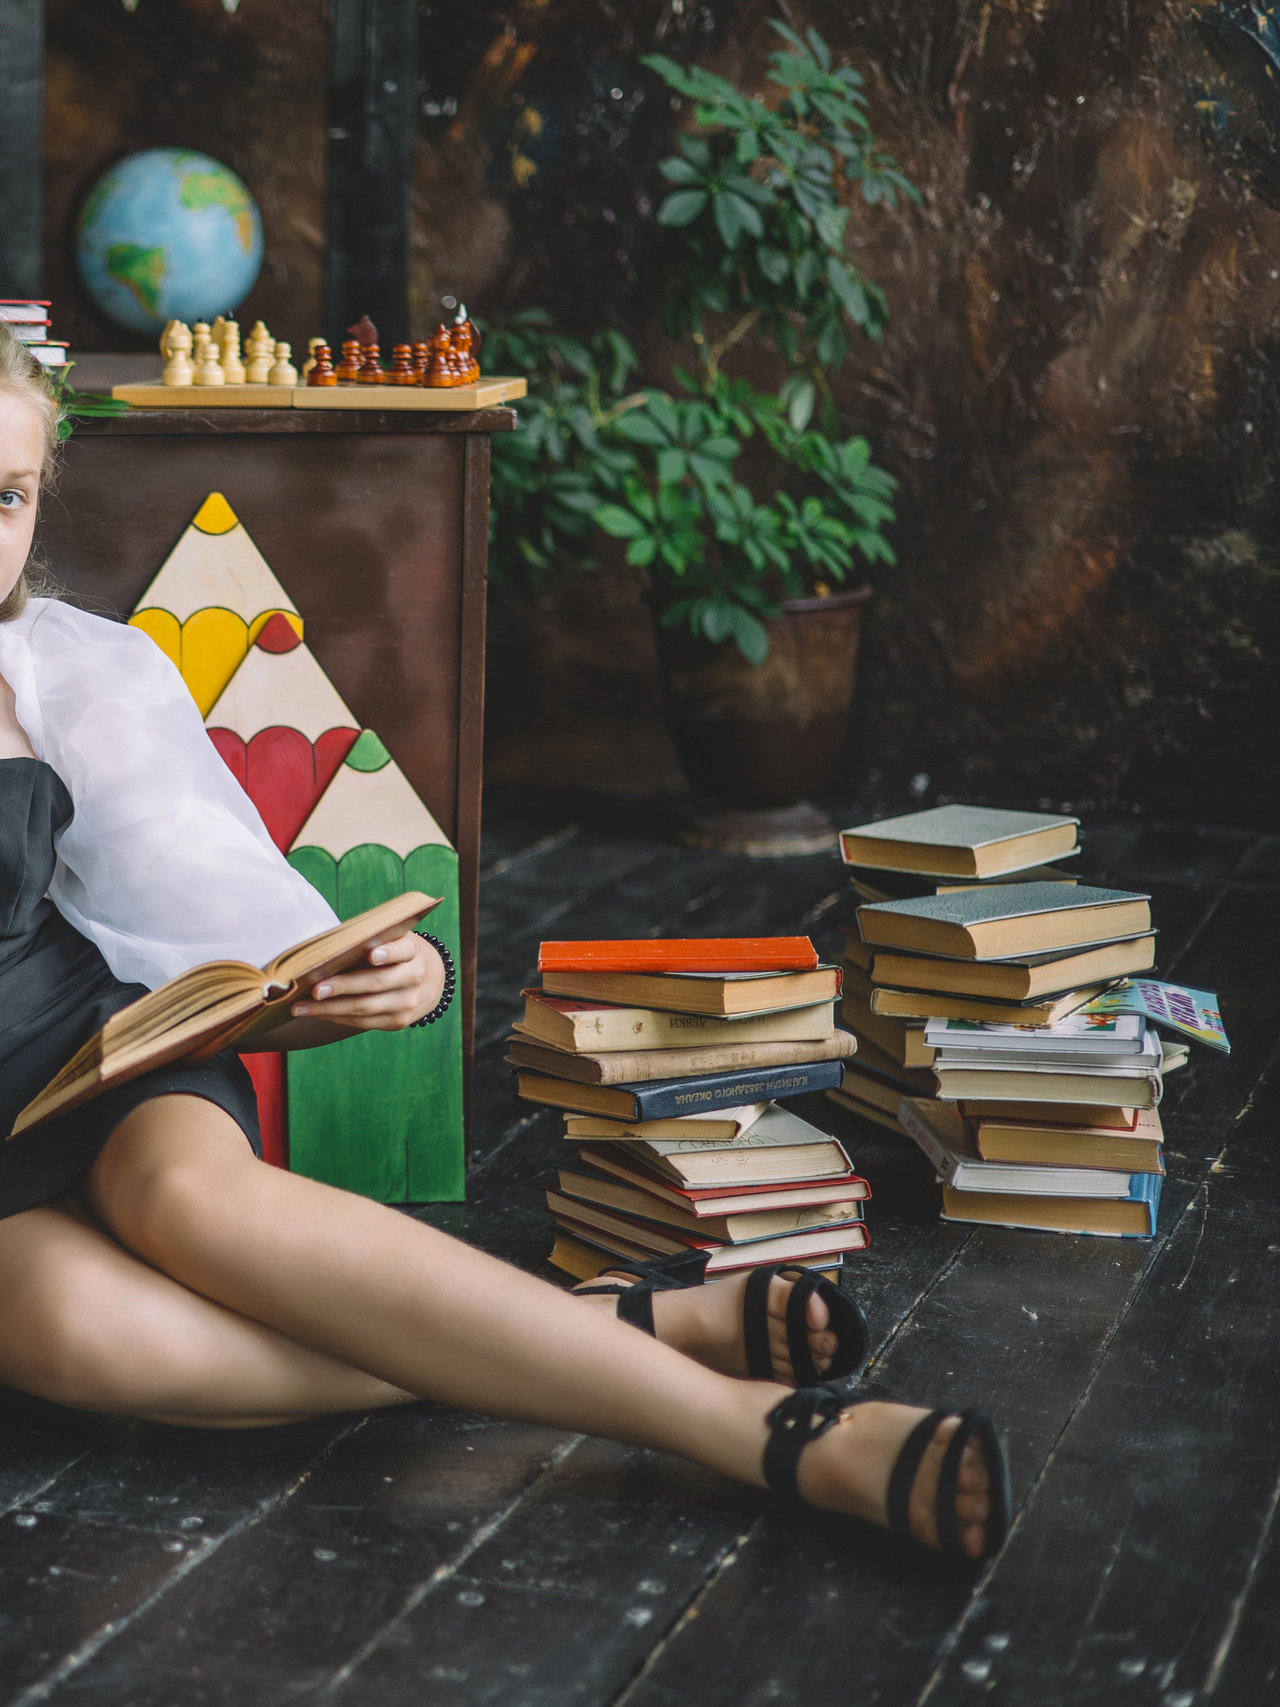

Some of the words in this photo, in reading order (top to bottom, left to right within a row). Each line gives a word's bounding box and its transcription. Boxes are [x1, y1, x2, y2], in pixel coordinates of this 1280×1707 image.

[1164, 991, 1201, 1030] ЧИТАЕМ
[714, 1082, 765, 1099] ЗВЕЗДНОГО
[766, 1075, 808, 1092] КАПИТАН
[675, 1090, 713, 1105] ОКЕАНА
